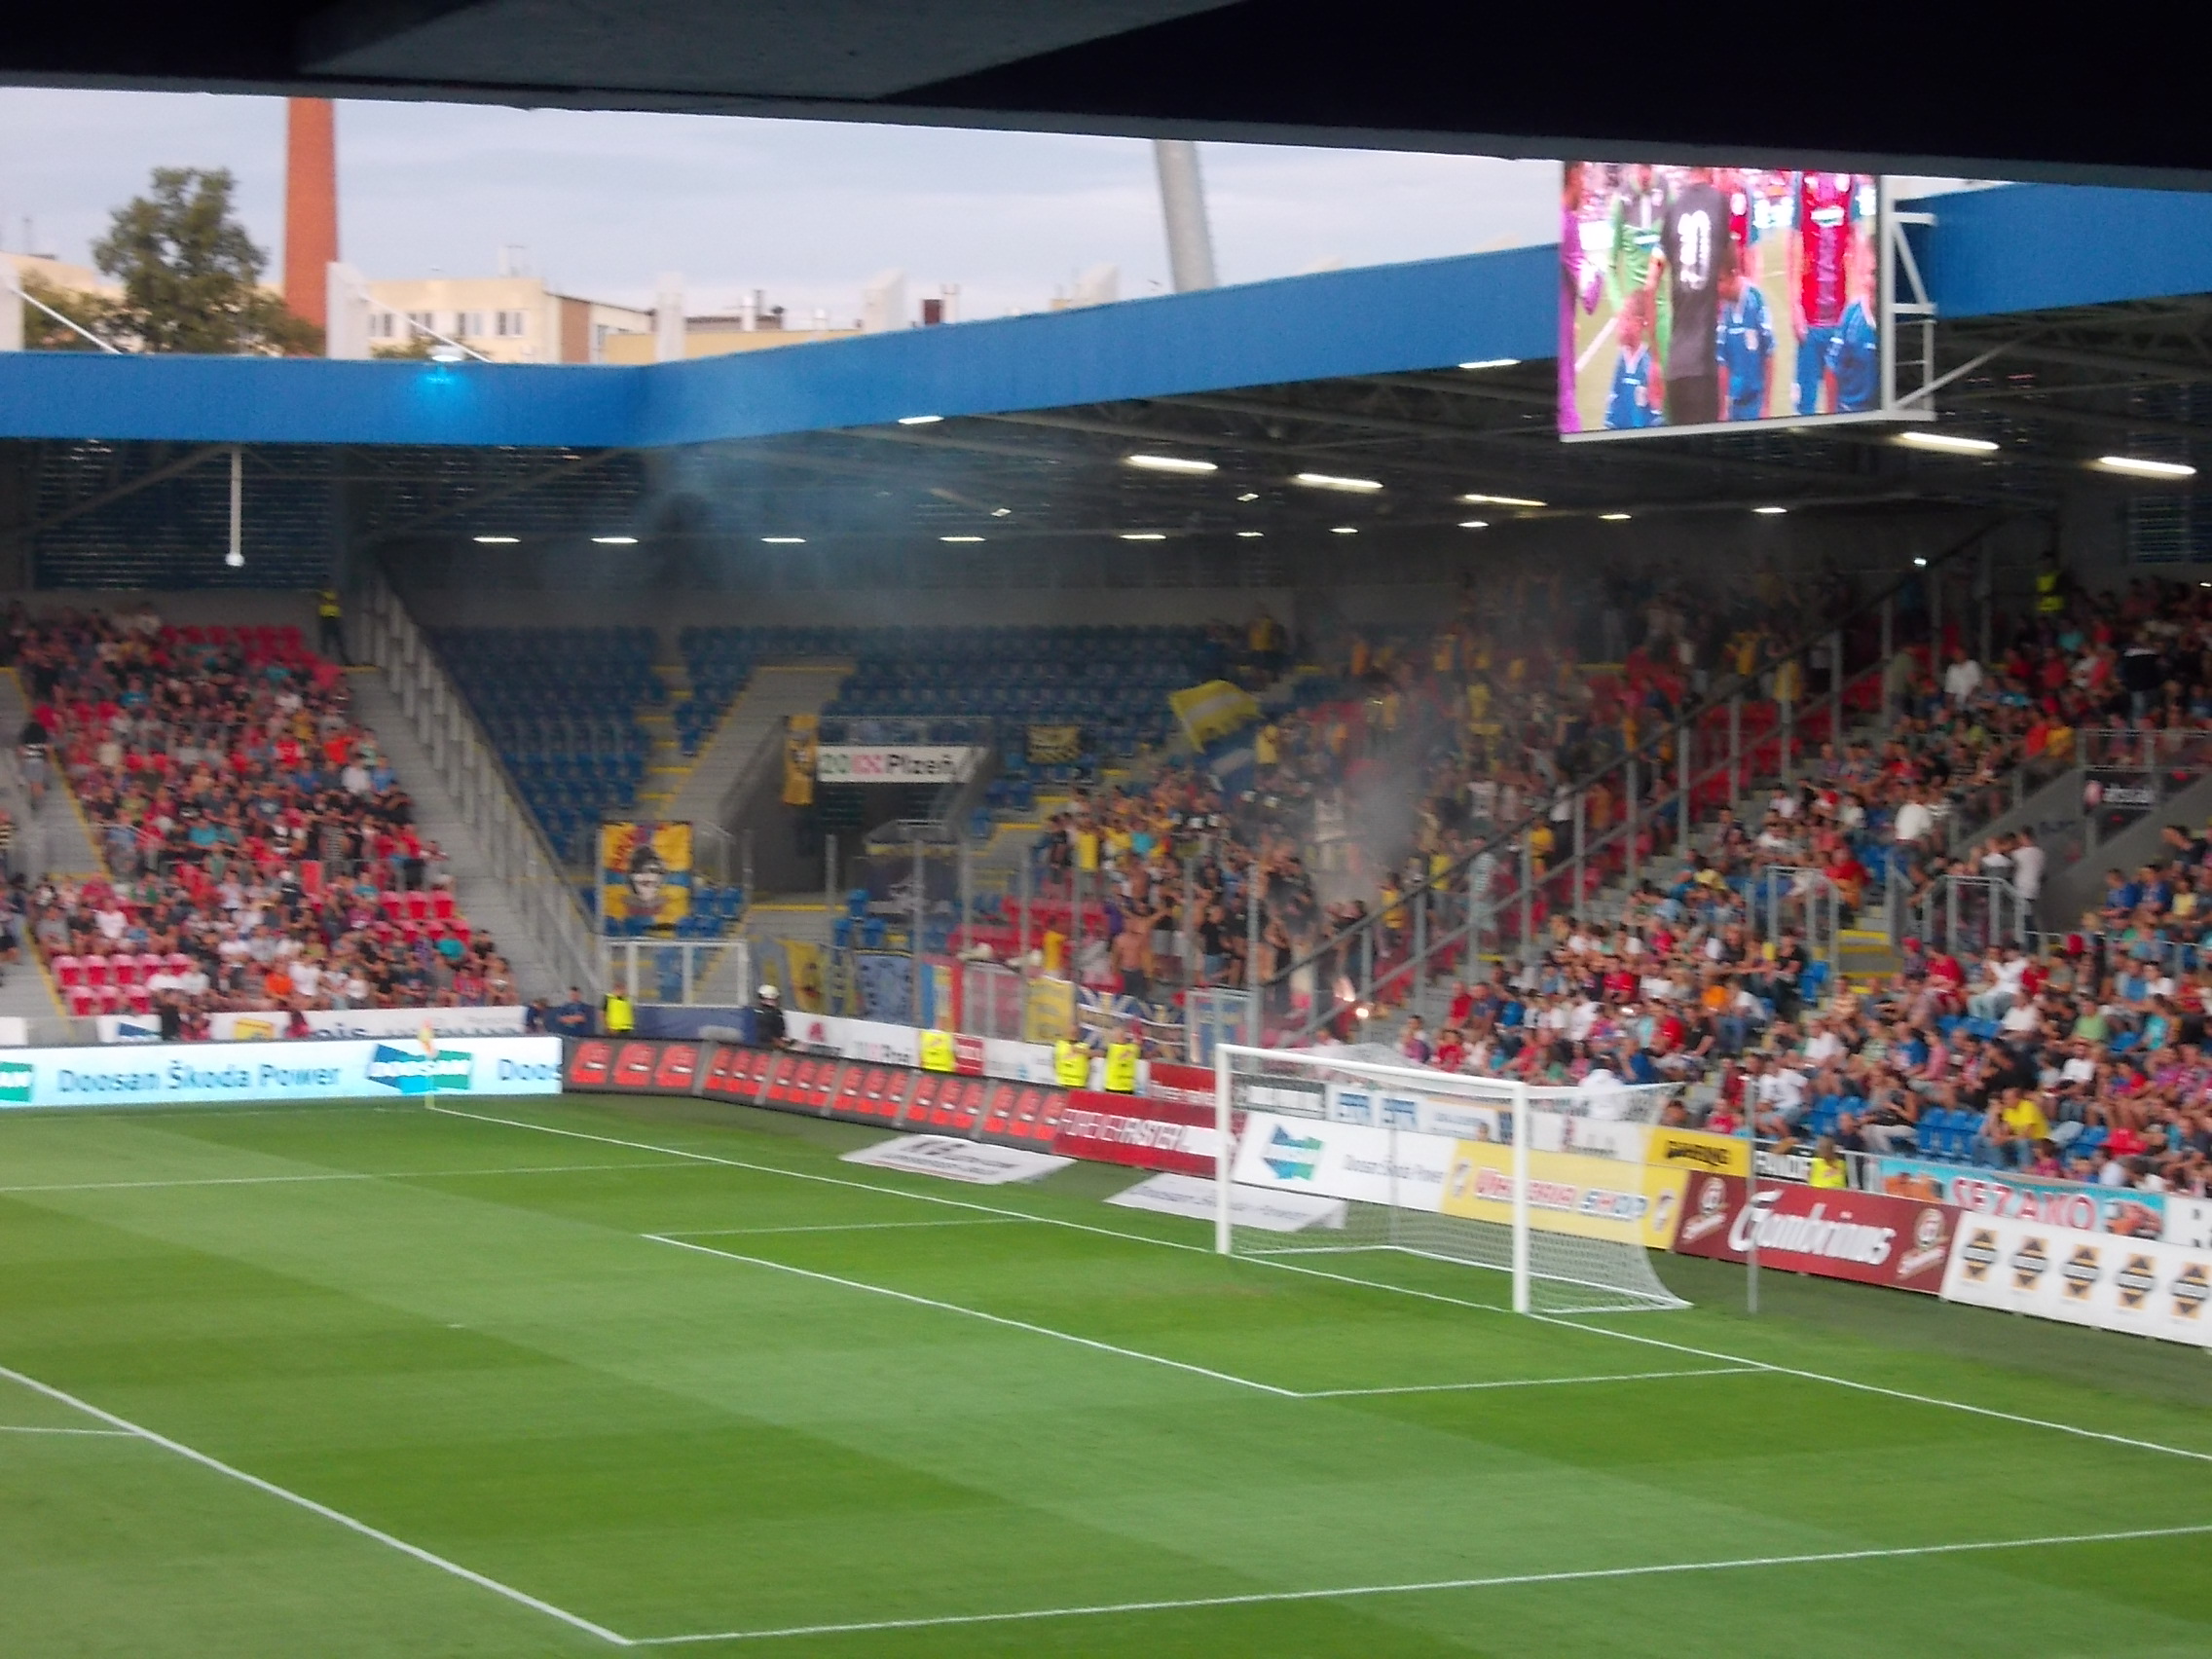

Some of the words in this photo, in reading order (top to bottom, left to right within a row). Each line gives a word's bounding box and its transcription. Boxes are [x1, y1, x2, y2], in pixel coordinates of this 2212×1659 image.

[57, 1069, 160, 1092] Doosan
[167, 1058, 250, 1089] Škoda
[258, 1063, 341, 1088] Power
[1727, 1188, 1897, 1266] Gambrinus
[1952, 1176, 2099, 1231] SEZAKO
